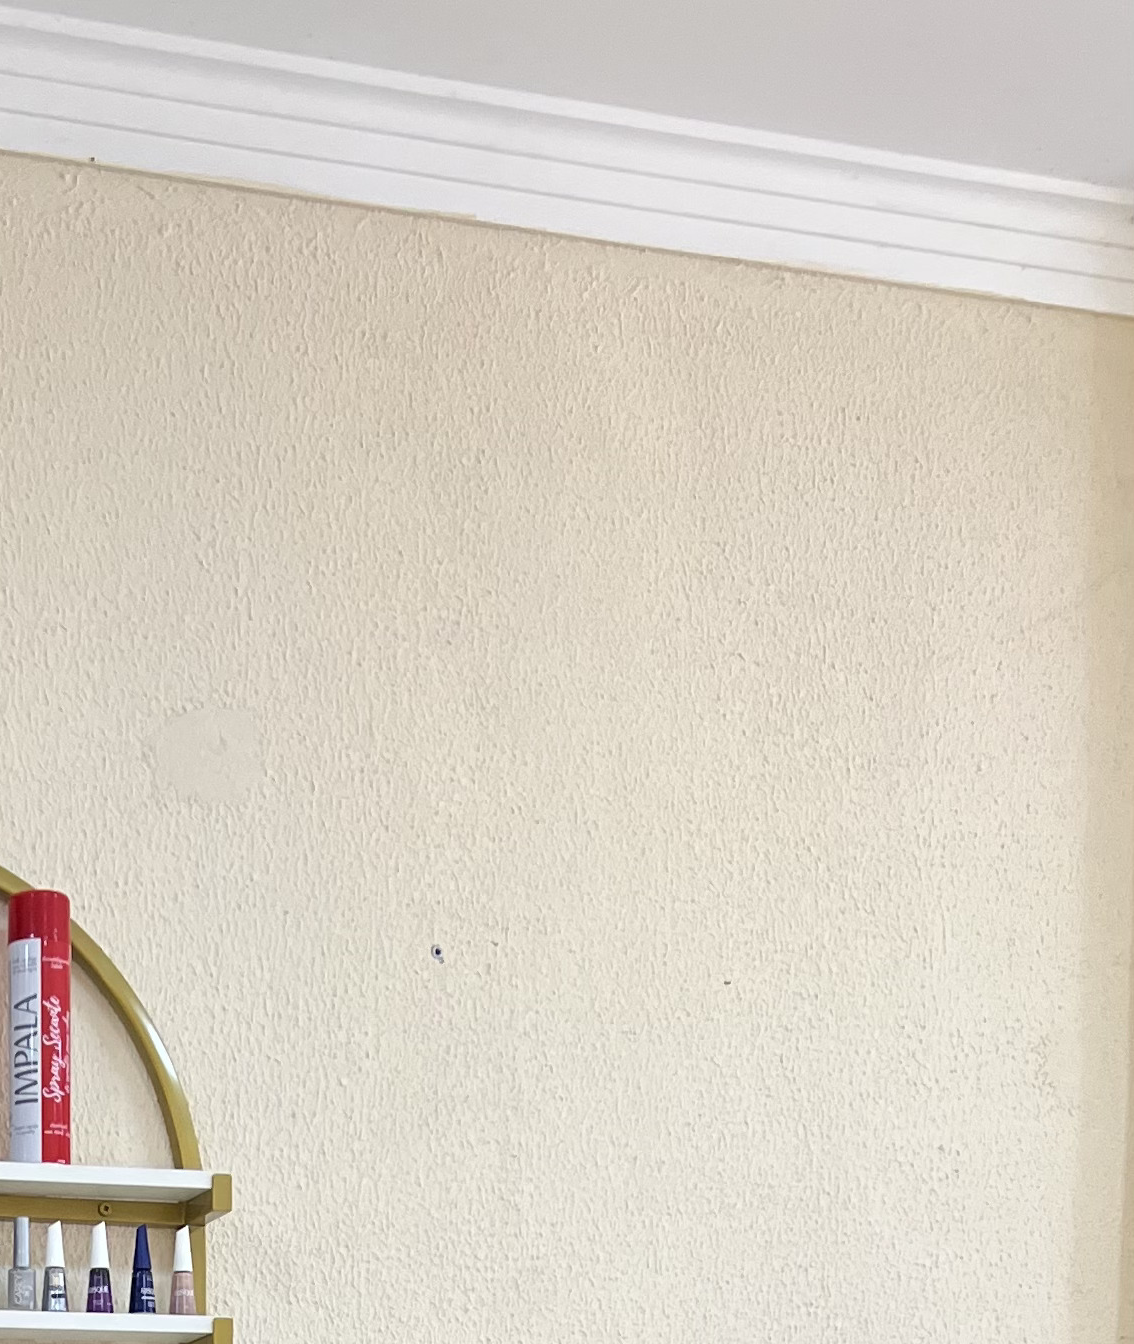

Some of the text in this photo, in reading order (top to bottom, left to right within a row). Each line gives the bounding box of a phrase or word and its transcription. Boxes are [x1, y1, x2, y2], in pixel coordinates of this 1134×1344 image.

[13, 993, 38, 1105] IMPALA
[42, 995, 62, 1052] Secante
[42, 1048, 65, 1103] Spray
